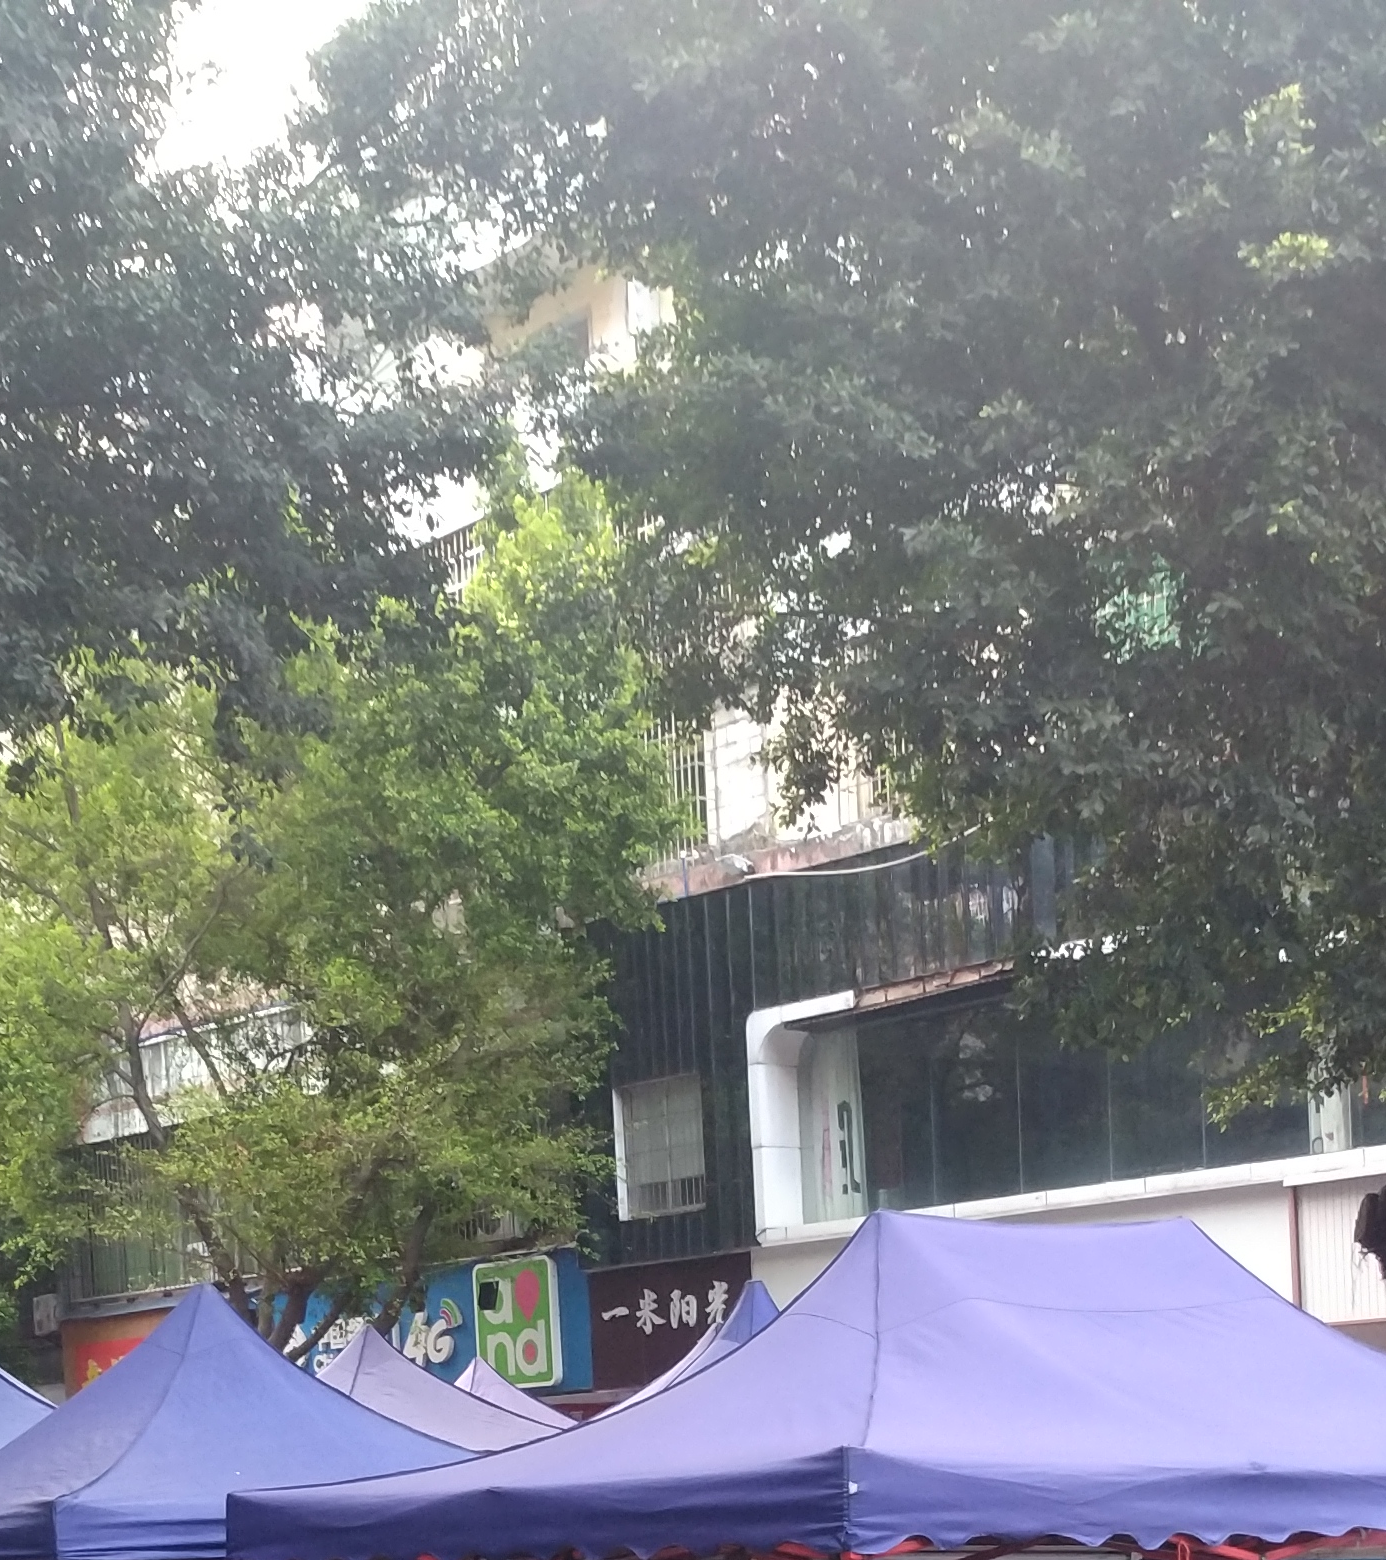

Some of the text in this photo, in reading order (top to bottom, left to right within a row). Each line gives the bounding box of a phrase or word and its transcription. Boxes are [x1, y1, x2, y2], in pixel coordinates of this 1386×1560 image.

[601, 1280, 729, 1335] 一米阳光
[403, 1311, 455, 1373] 4G
